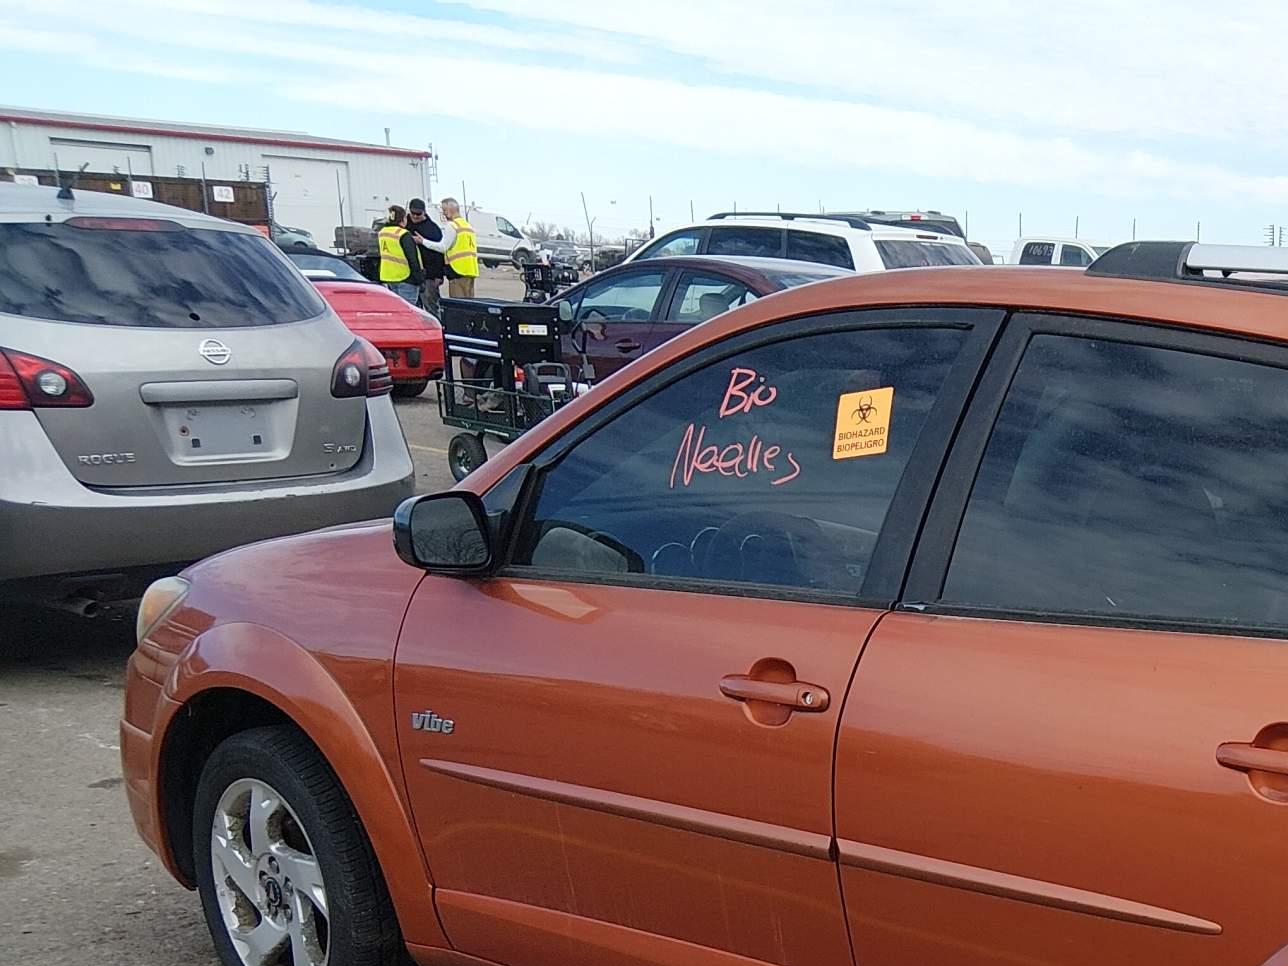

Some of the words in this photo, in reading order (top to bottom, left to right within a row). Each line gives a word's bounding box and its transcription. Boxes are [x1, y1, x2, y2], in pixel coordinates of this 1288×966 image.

[216, 187, 232, 199] 42
[719, 368, 777, 418] Bio
[838, 427, 886, 441] BIOHAZARD
[836, 439, 884, 452] BIOPELIGRO
[78, 452, 136, 465] ROGUE
[670, 423, 801, 488] Needles
[411, 710, 454, 734] Vibe
